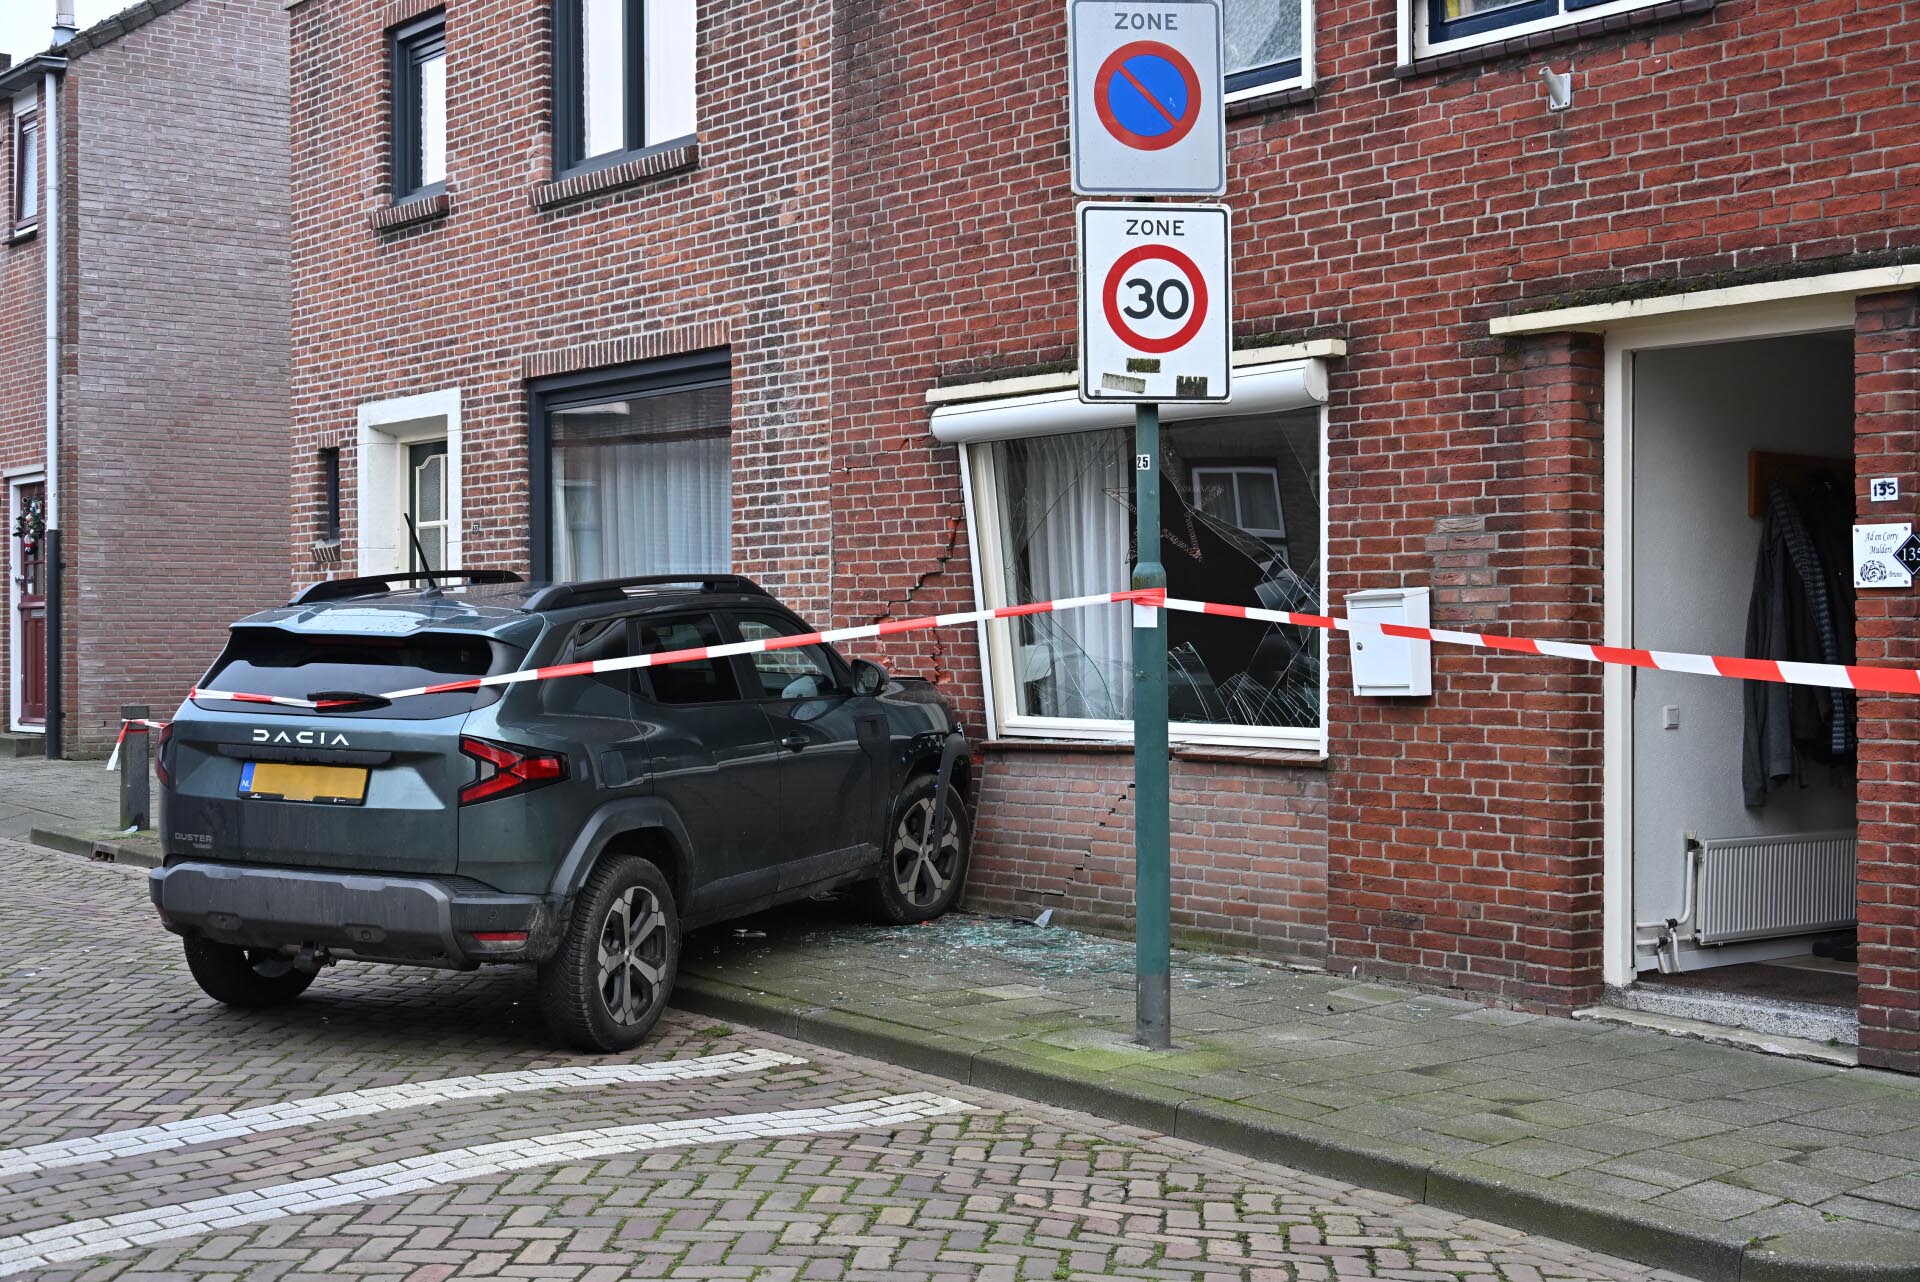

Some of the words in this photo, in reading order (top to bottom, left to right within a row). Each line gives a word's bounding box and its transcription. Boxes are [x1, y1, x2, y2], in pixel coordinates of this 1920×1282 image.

[1114, 12, 1178, 31] ZONE
[1125, 219, 1185, 236] ZONE
[1123, 278, 1189, 320] 30
[1136, 456, 1149, 469] 25
[1873, 481, 1896, 497] 135
[1864, 531, 1874, 542] Ad
[1874, 533, 1882, 541] en
[1882, 531, 1899, 543] Corry
[1869, 544, 1893, 554] Mulders
[252, 729, 350, 746] DACIA
[241, 779, 250, 788] NL
[174, 831, 213, 843] DUSTER
